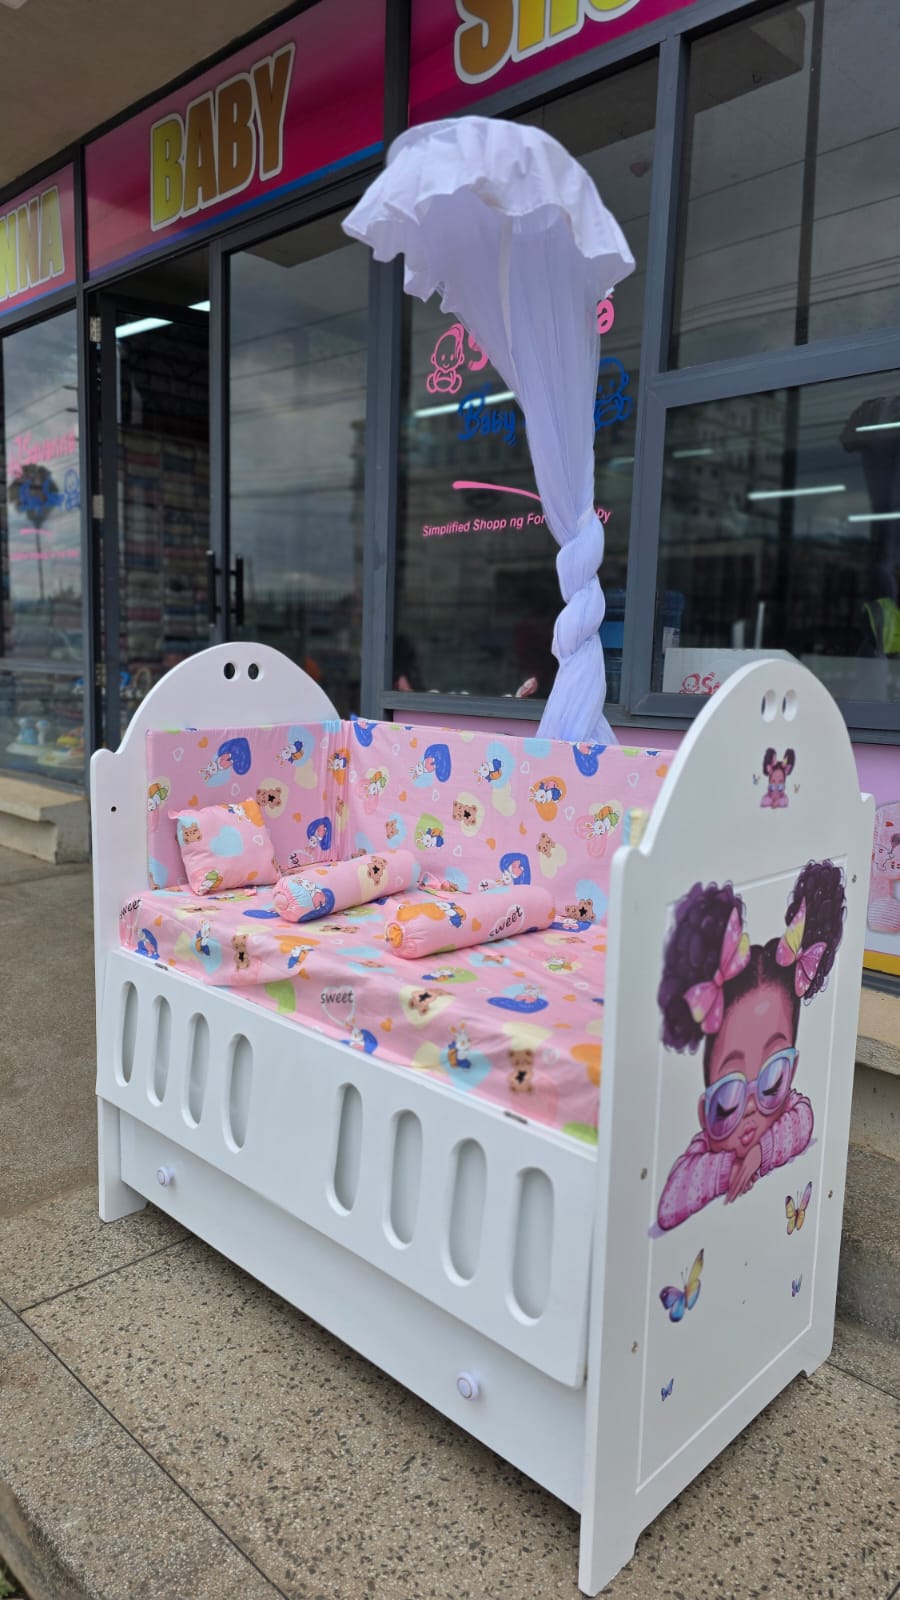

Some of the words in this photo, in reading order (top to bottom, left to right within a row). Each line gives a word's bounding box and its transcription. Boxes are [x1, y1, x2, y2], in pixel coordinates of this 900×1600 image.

[151, 41, 296, 232] BABY
[457, 391, 517, 447] Baby
[422, 518, 470, 537] Simplified
[472, 516, 524, 532] Shoppng
[489, 905, 523, 934] sweet
[319, 990, 354, 1004] sweet
